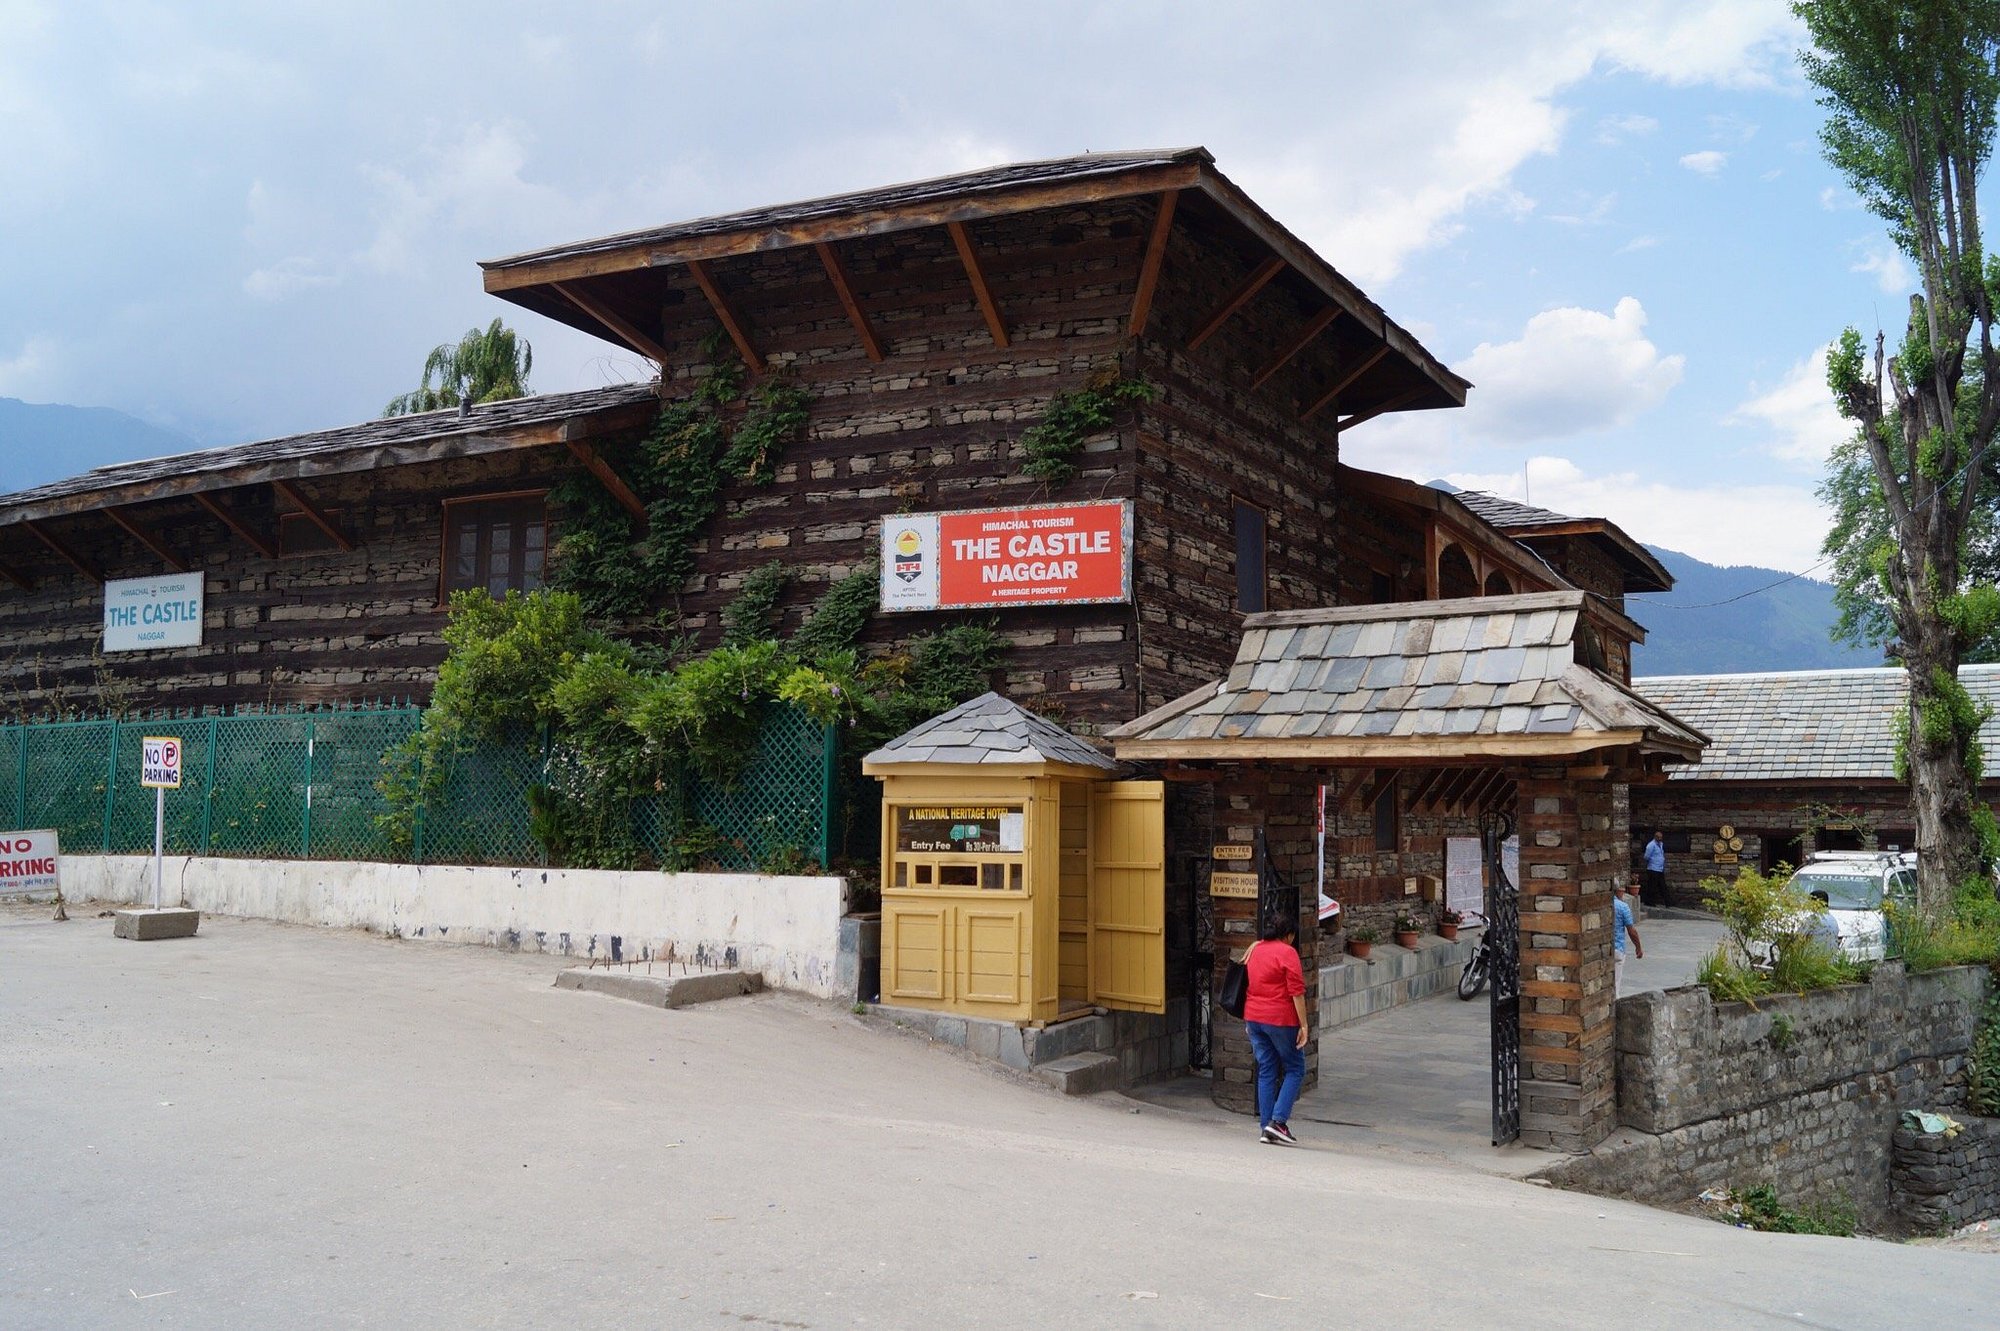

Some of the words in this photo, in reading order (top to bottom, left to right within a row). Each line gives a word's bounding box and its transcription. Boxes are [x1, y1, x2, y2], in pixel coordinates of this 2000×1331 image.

[982, 520, 1030, 531] HIMACHAL
[1032, 517, 1074, 529] TOURISM
[952, 538, 1001, 561] THE
[1008, 531, 1111, 558] CASTLE
[982, 561, 1078, 583] NAGGAR
[121, 588, 148, 597] HIMACHAL
[160, 584, 185, 593] TOURISM
[998, 588, 1030, 596] HERITAGE
[1031, 586, 1068, 595] PROPERTY
[109, 606, 137, 627] THE
[142, 600, 196, 625] CASTLE
[138, 632, 165, 641] NAGGAR
[145, 748, 160, 765] NO
[144, 768, 178, 783] PARKING
[909, 809, 915, 820] A
[915, 808, 949, 820] NATIONAL
[951, 808, 986, 820] HERITAGE
[0, 839, 32, 854] NO
[911, 841, 934, 851] Entry
[935, 841, 951, 850] Fee
[1213, 876, 1239, 885] VISITING
